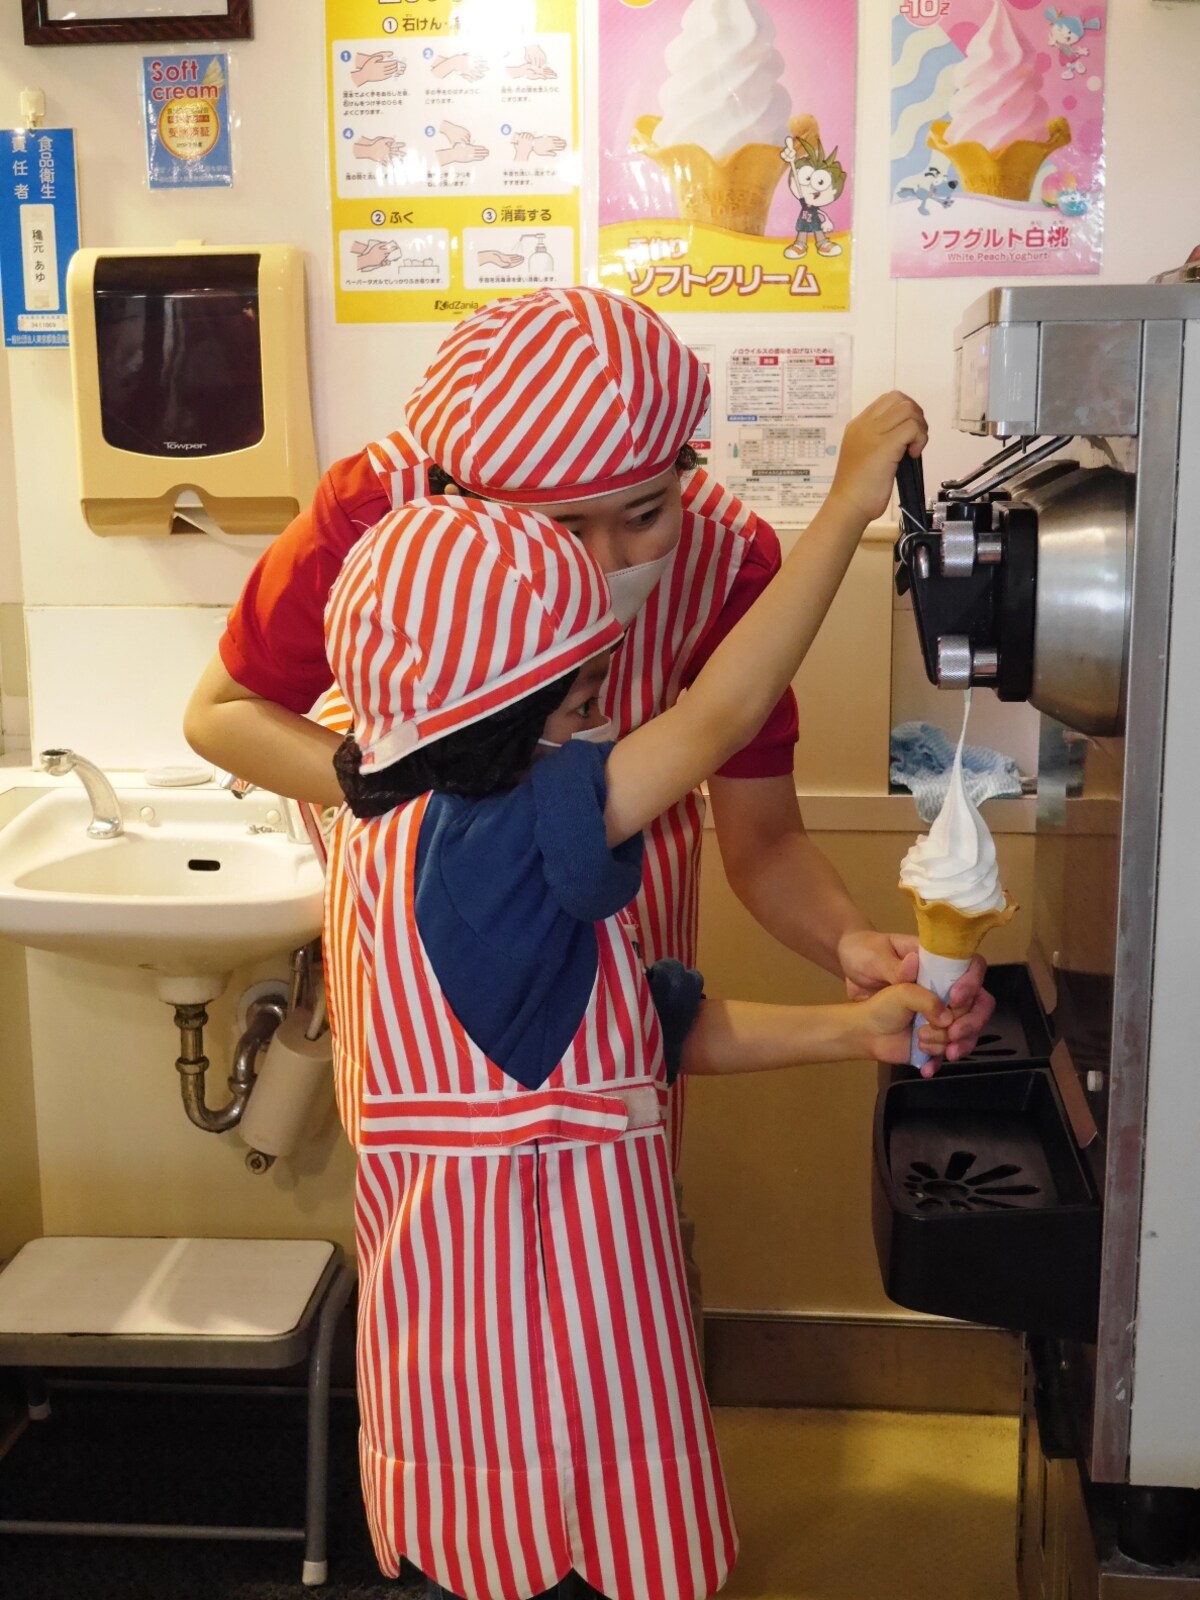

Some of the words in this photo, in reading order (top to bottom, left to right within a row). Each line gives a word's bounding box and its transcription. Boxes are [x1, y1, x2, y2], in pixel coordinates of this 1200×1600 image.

[151, 60, 198, 83] Soft
[152, 84, 218, 101] cream
[11, 136, 30, 200] 責任者
[38, 135, 56, 199] 食品衛生
[389, 211, 414, 224] ふく
[501, 208, 552, 223] 消毒する
[921, 225, 1070, 250] ソフグルト白桃
[947, 253, 975, 261] White
[977, 252, 1006, 261] Peach
[1008, 251, 1049, 262] Yoghurt
[628, 264, 821, 297] ソフトクリーム
[434, 299, 479, 311] KidZania
[163, 441, 208, 451] Towper
